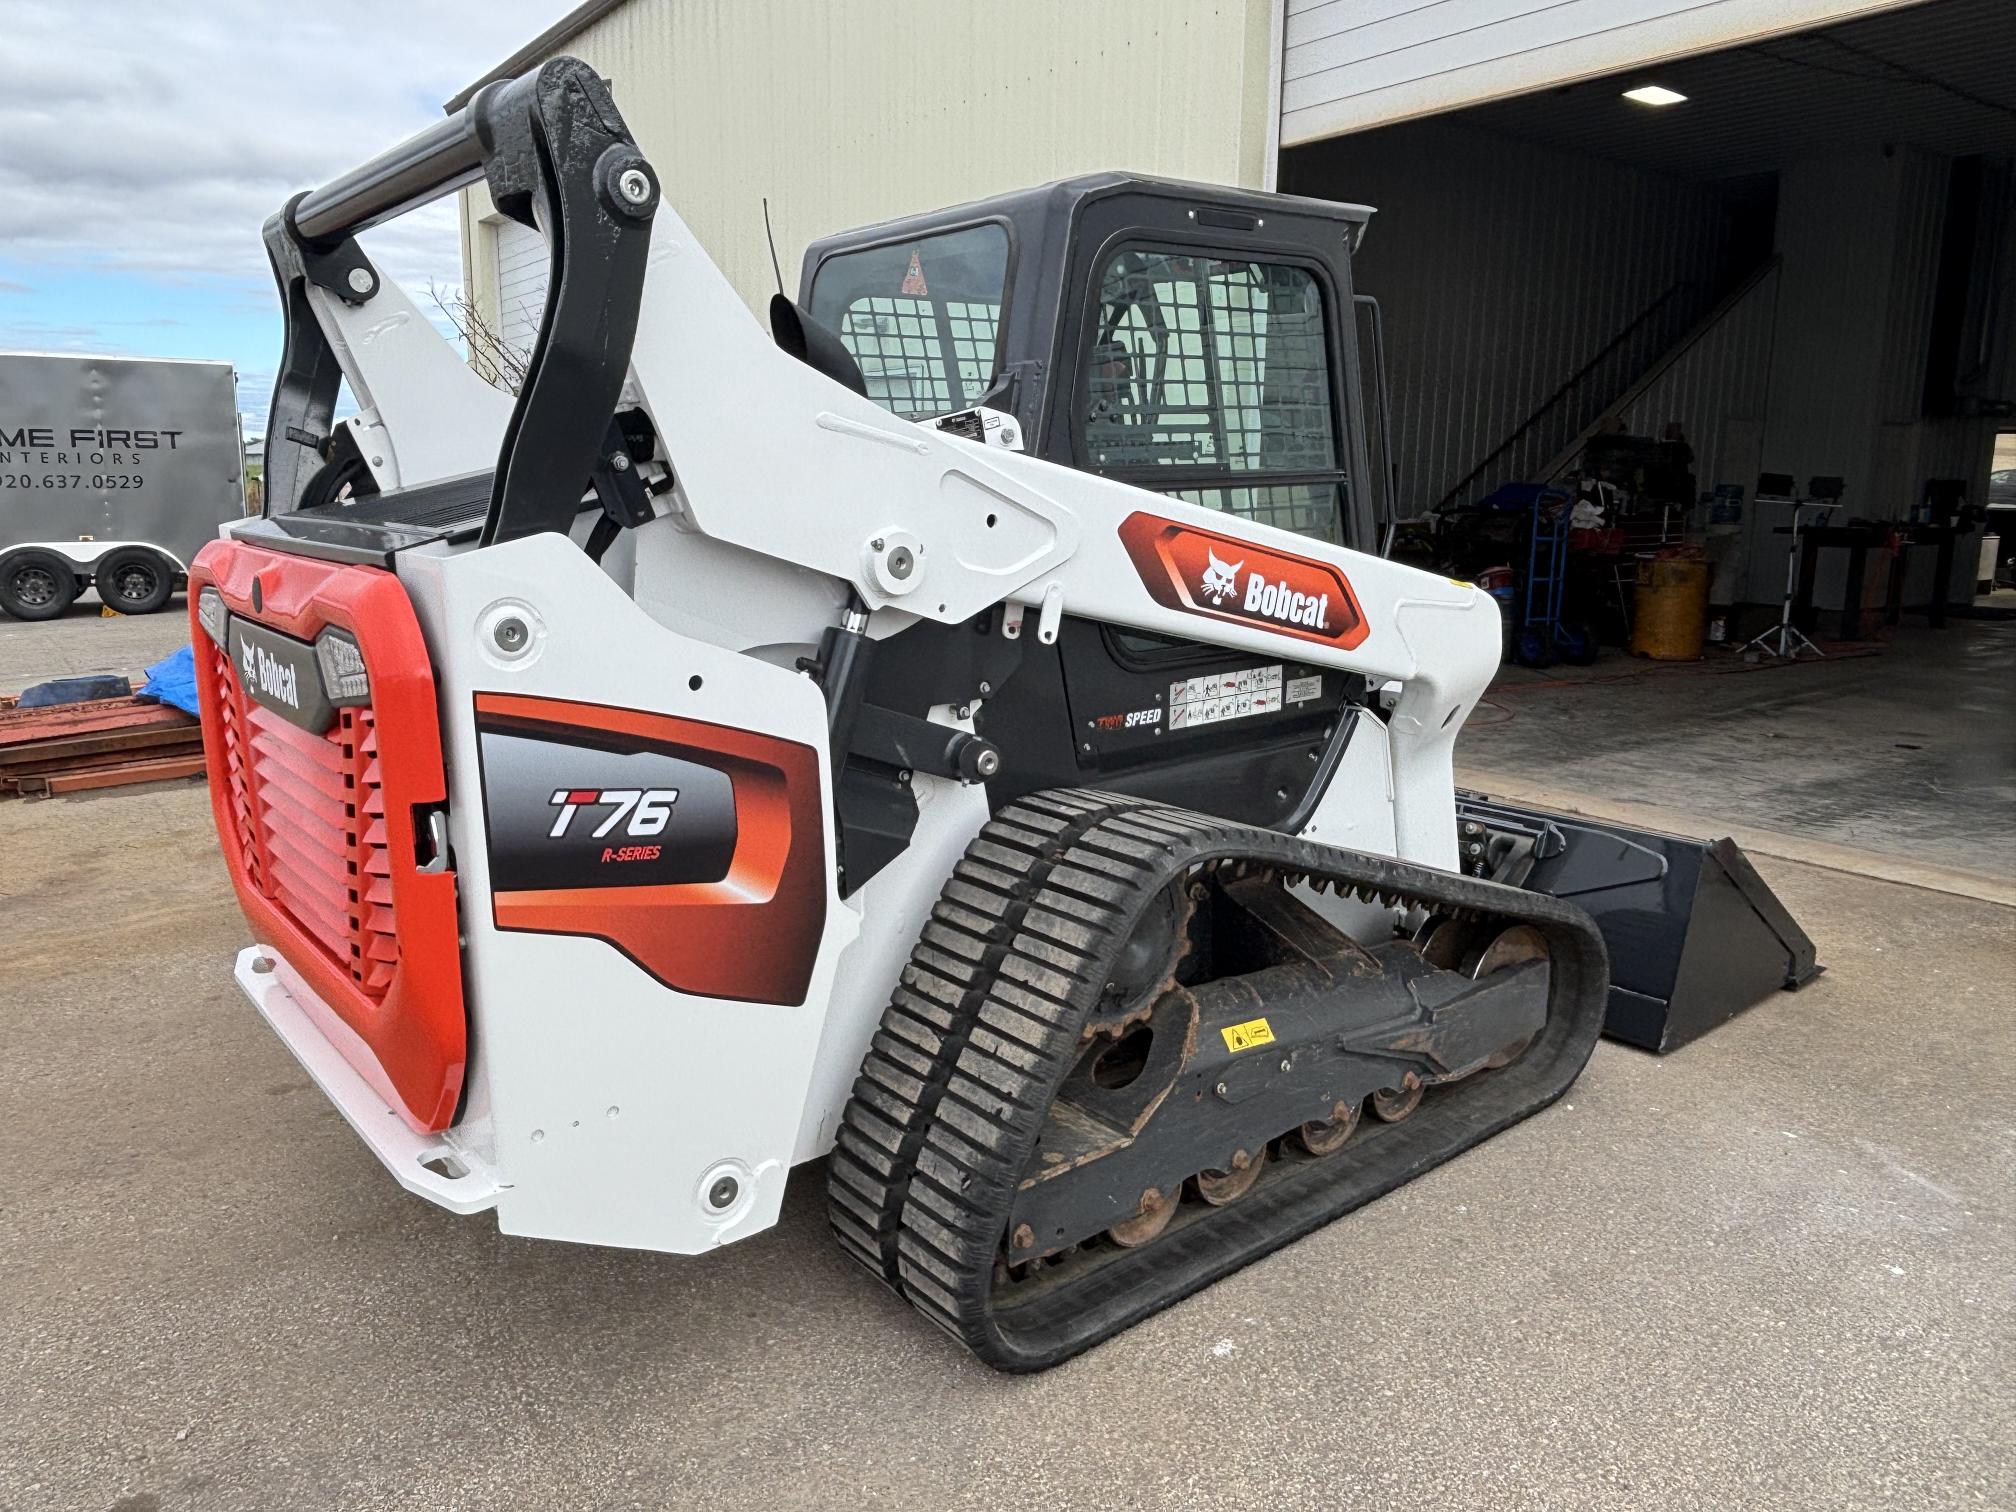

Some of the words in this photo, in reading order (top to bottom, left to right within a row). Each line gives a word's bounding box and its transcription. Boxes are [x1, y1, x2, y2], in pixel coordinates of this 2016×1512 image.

[70, 429, 184, 450] FIRST
[0, 452, 141, 465] NTERIORS
[0, 474, 144, 489] 20.637.0529
[1243, 572, 1328, 630] Bobcat
[257, 647, 299, 710] Bobcat
[1125, 708, 1162, 728] SPEED
[548, 788, 680, 838] T76
[601, 845, 662, 863] R-SERIES
